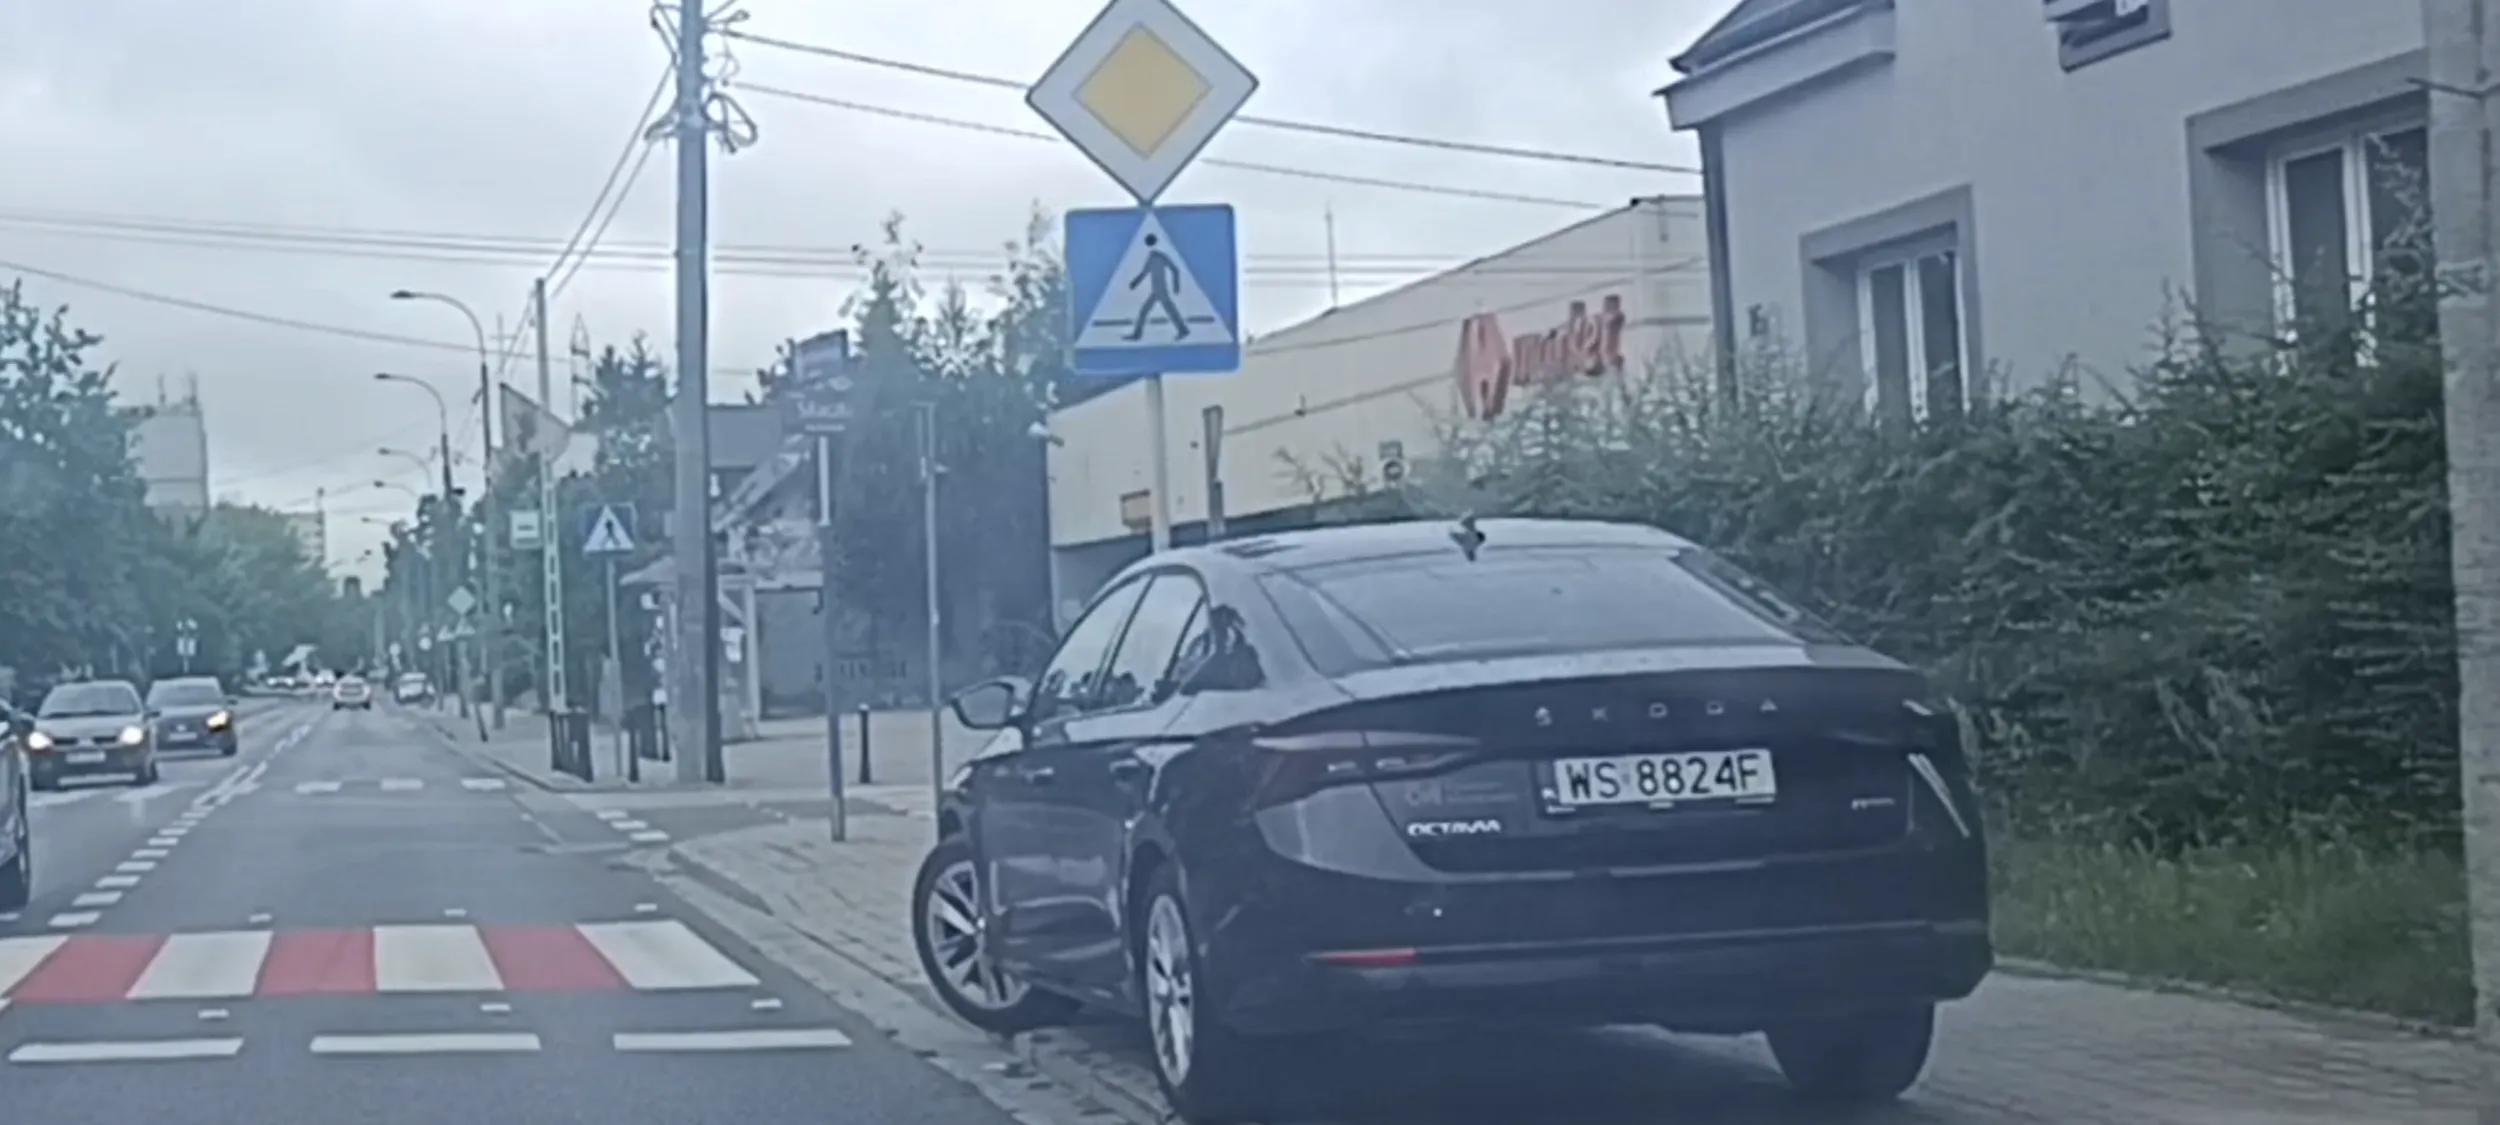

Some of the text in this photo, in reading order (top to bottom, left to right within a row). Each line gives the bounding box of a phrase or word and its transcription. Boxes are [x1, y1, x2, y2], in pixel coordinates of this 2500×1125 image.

[1512, 294, 1625, 387] market
[1565, 761, 1621, 800] WS
[1635, 753, 1761, 797] 8824F
